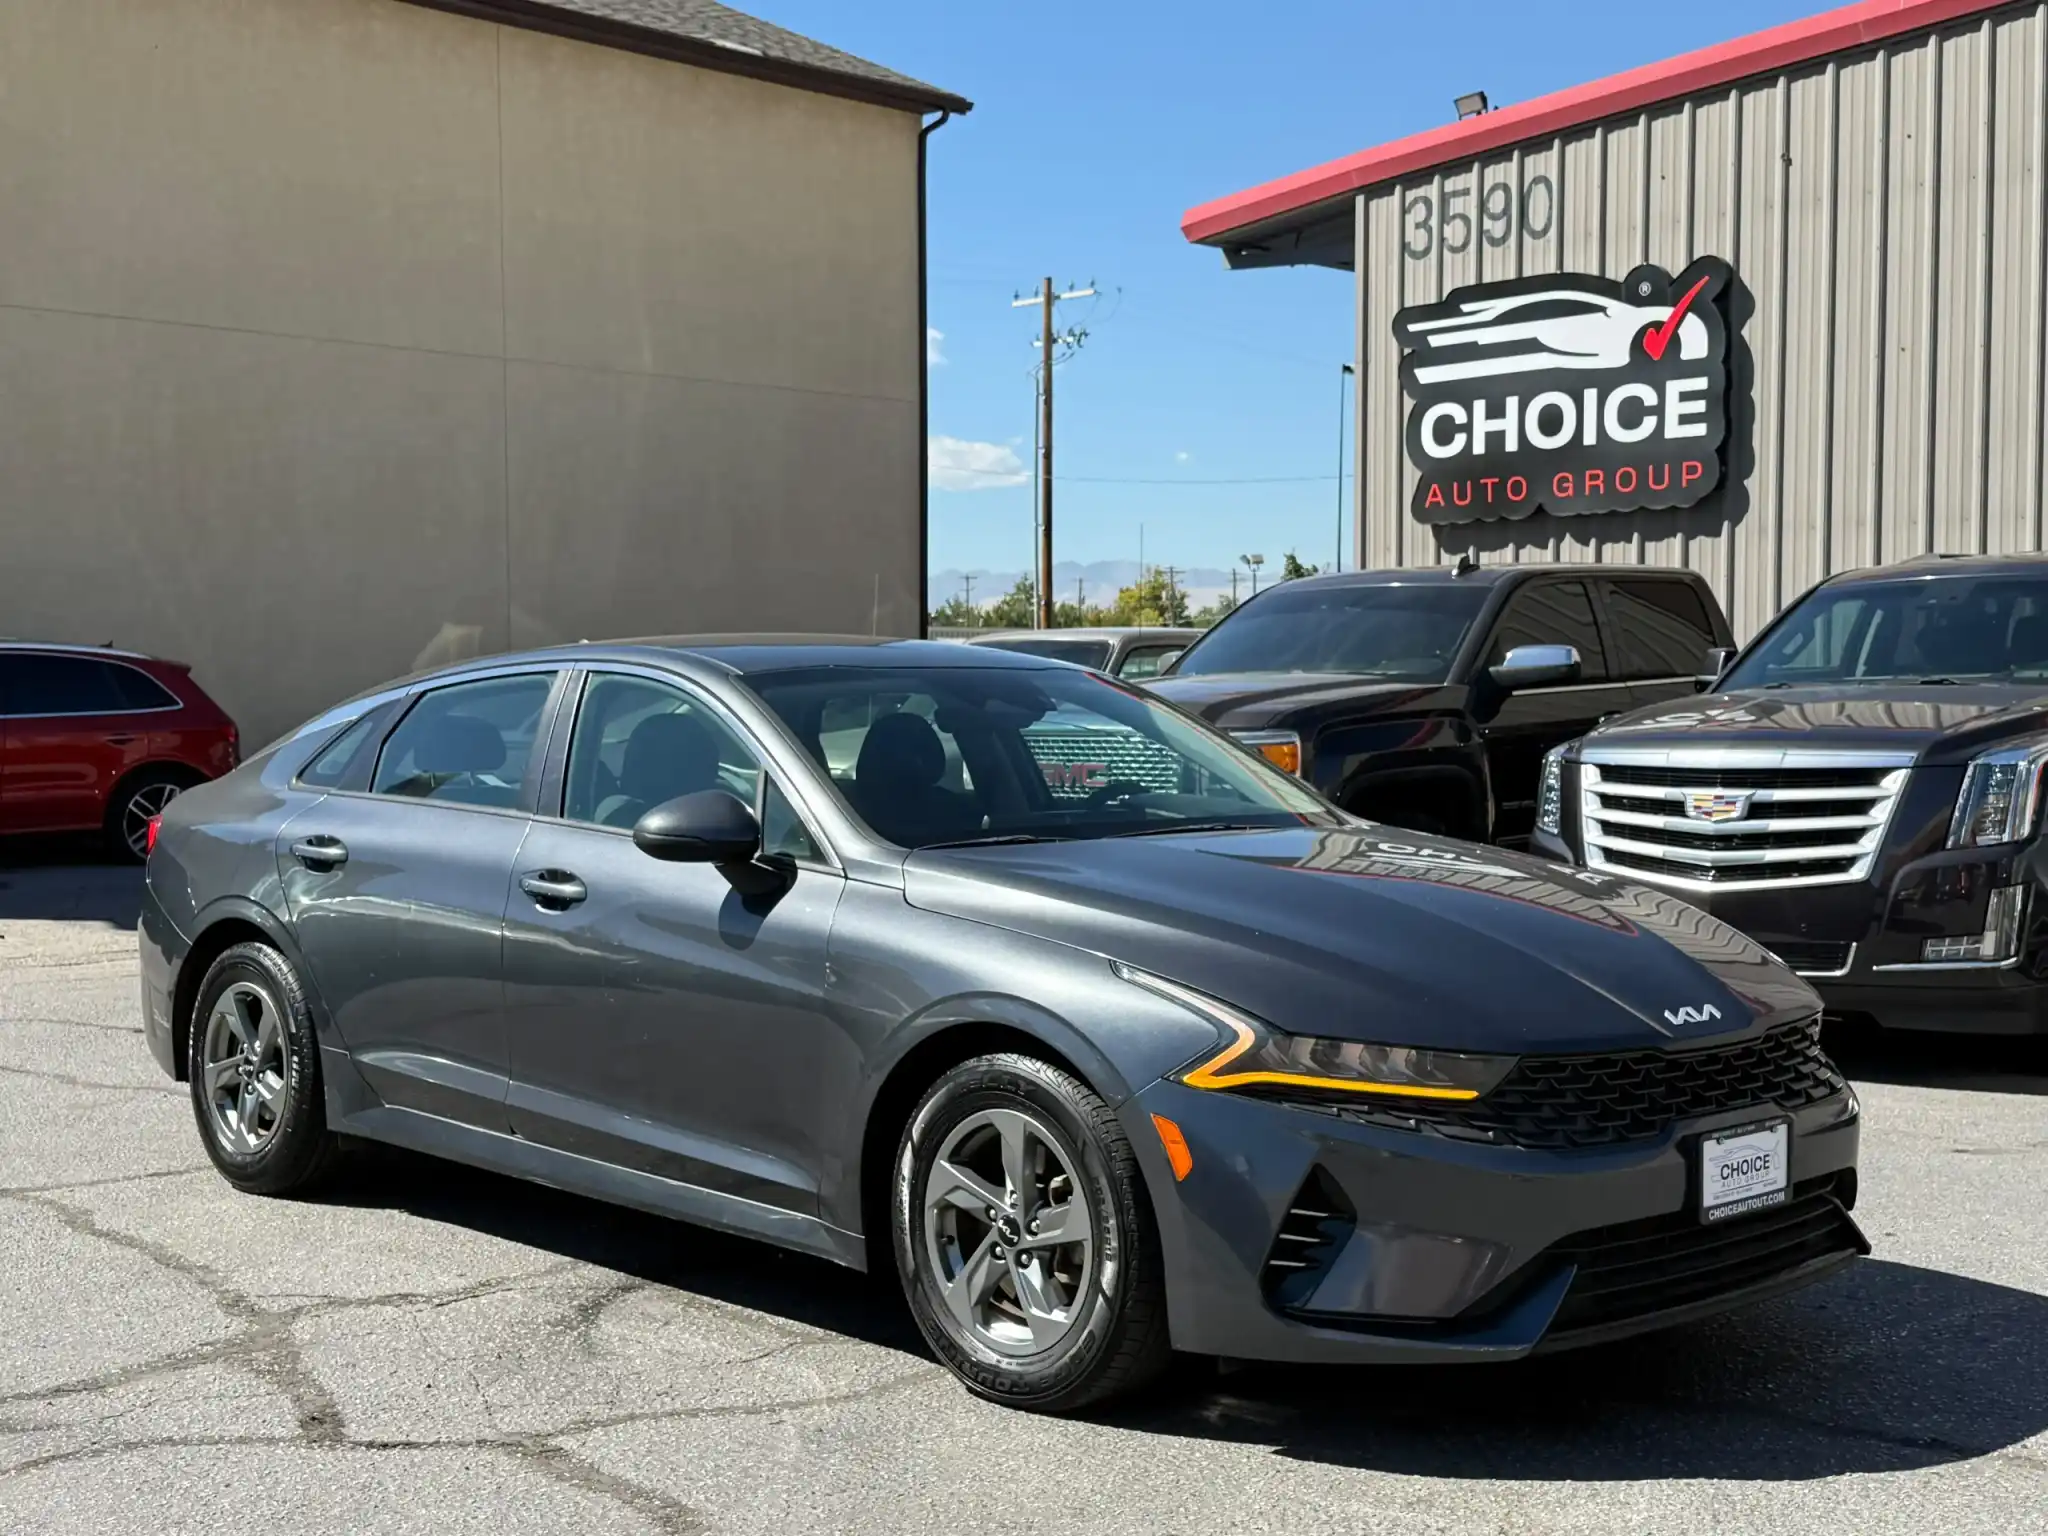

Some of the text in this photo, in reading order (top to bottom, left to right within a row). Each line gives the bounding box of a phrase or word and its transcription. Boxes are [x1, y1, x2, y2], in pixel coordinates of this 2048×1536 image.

[1404, 174, 1554, 261] 3590
[1420, 376, 1709, 459] CHOICE
[1425, 461, 1703, 509] AUTO GROUP
[1663, 1003, 1722, 1026] KIA
[1720, 1153, 1771, 1181] CHOICE
[1720, 1178, 1742, 1189] AUTO
[1744, 1169, 1771, 1184] GROUP
[1708, 1190, 1785, 1220] CHOICEAUTOUT.COM
